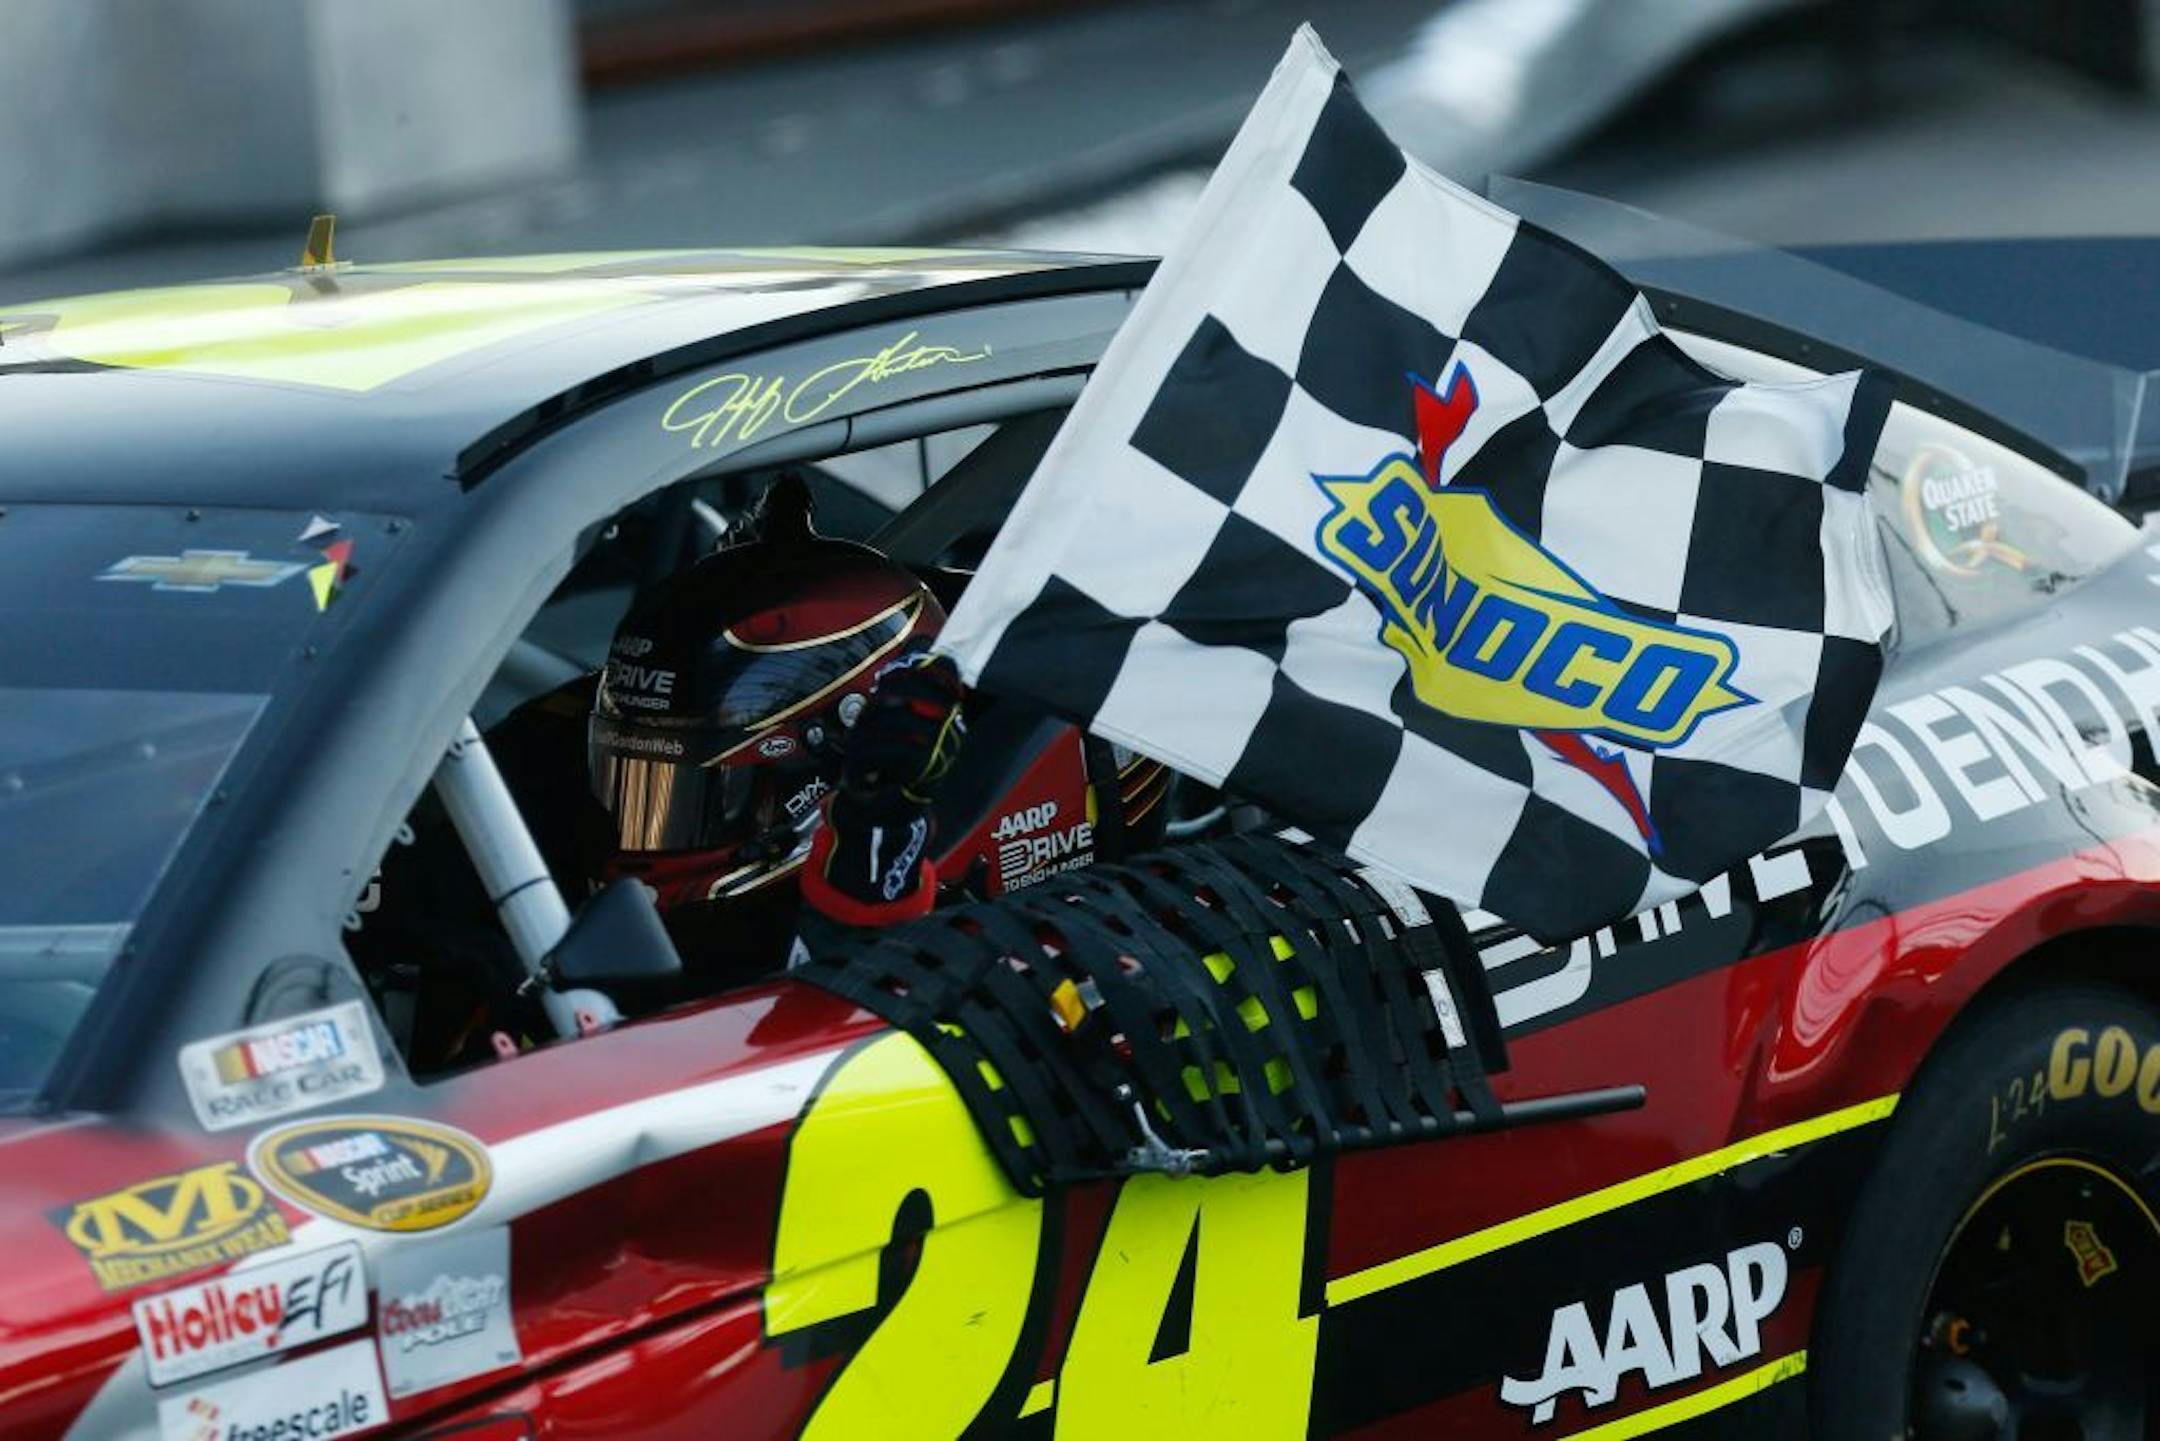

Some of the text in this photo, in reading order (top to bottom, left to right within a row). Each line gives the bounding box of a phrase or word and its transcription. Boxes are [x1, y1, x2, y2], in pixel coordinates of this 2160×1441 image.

[1922, 465, 1998, 510] QUAKER
[1944, 494, 2000, 532] STATE
[1336, 476, 1719, 733] SUNOCO
[1884, 658, 2134, 822] END
[990, 800, 1058, 840] AARP
[999, 822, 1094, 880] DRIVE
[298, 1065, 364, 1093] CAR
[341, 1152, 423, 1197] Sprint
[764, 1030, 1321, 1441] 24
[145, 1256, 354, 1360] Holley EFI
[1501, 1241, 1788, 1425] AARP
